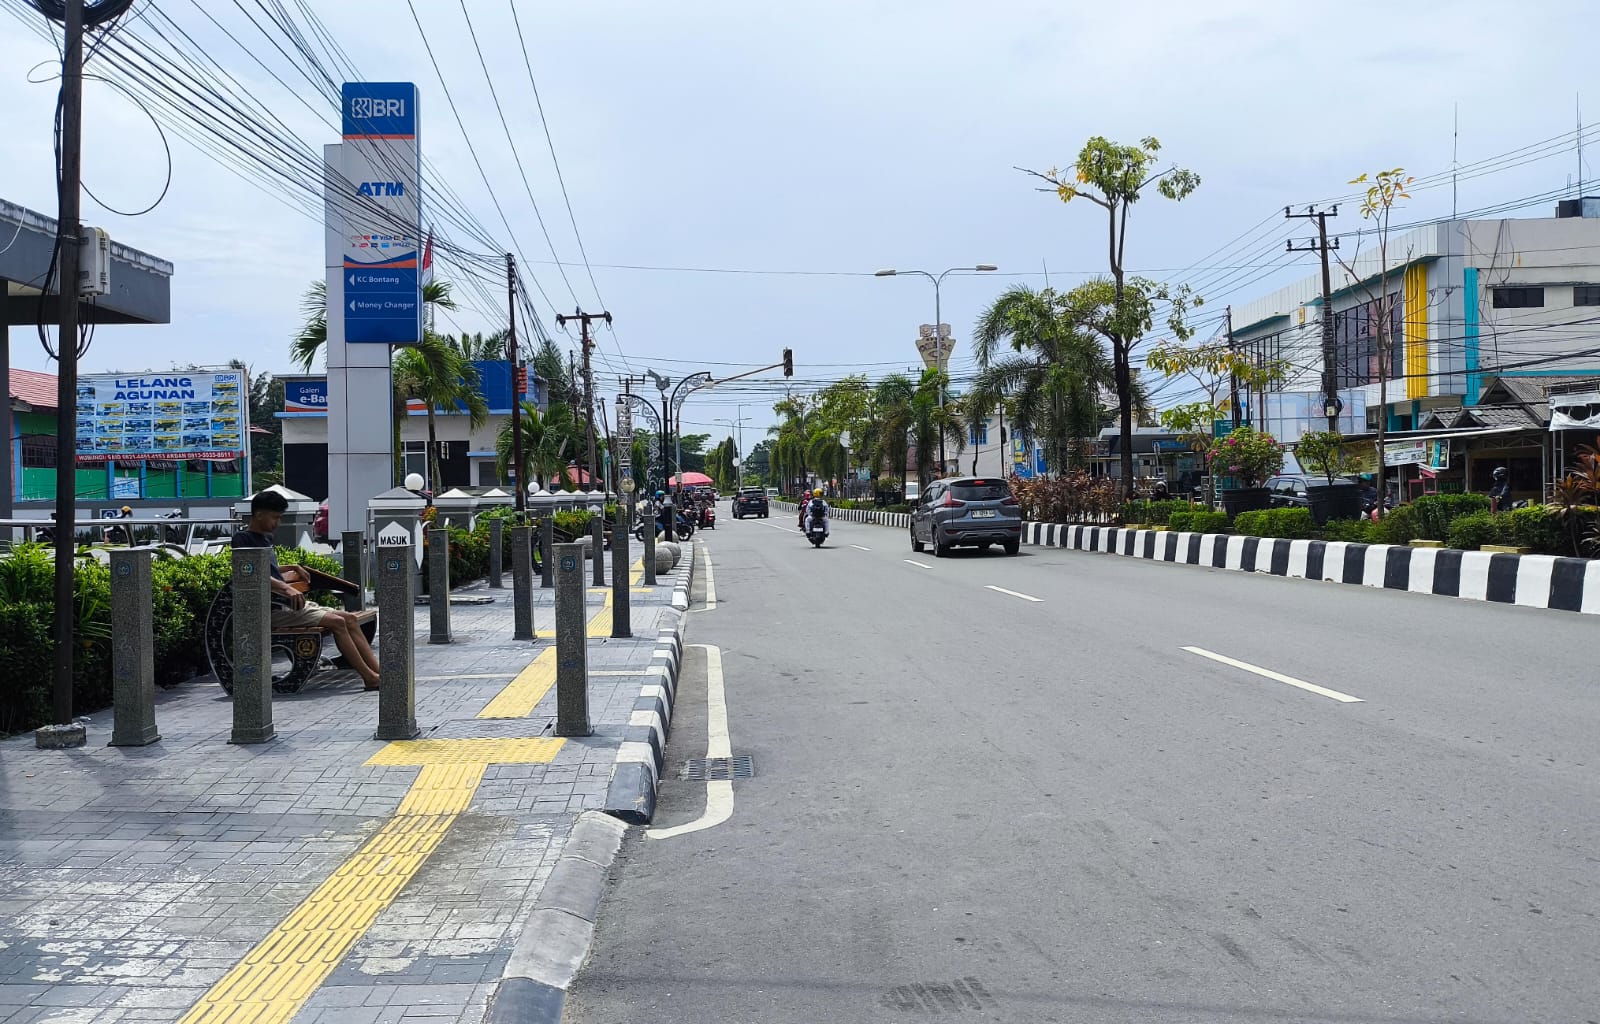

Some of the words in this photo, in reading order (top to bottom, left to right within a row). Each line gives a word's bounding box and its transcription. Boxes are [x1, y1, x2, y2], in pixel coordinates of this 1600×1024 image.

[373, 99, 405, 117] BRI
[356, 182, 404, 197] ATM
[369, 276, 399, 285] Bontang
[357, 301, 383, 310] Money
[384, 301, 415, 310] Changer
[115, 377, 192, 389] LELANG
[114, 389, 195, 401] AGUNAN
[299, 386, 320, 394] Galeri
[380, 535, 407, 545] MASUK
